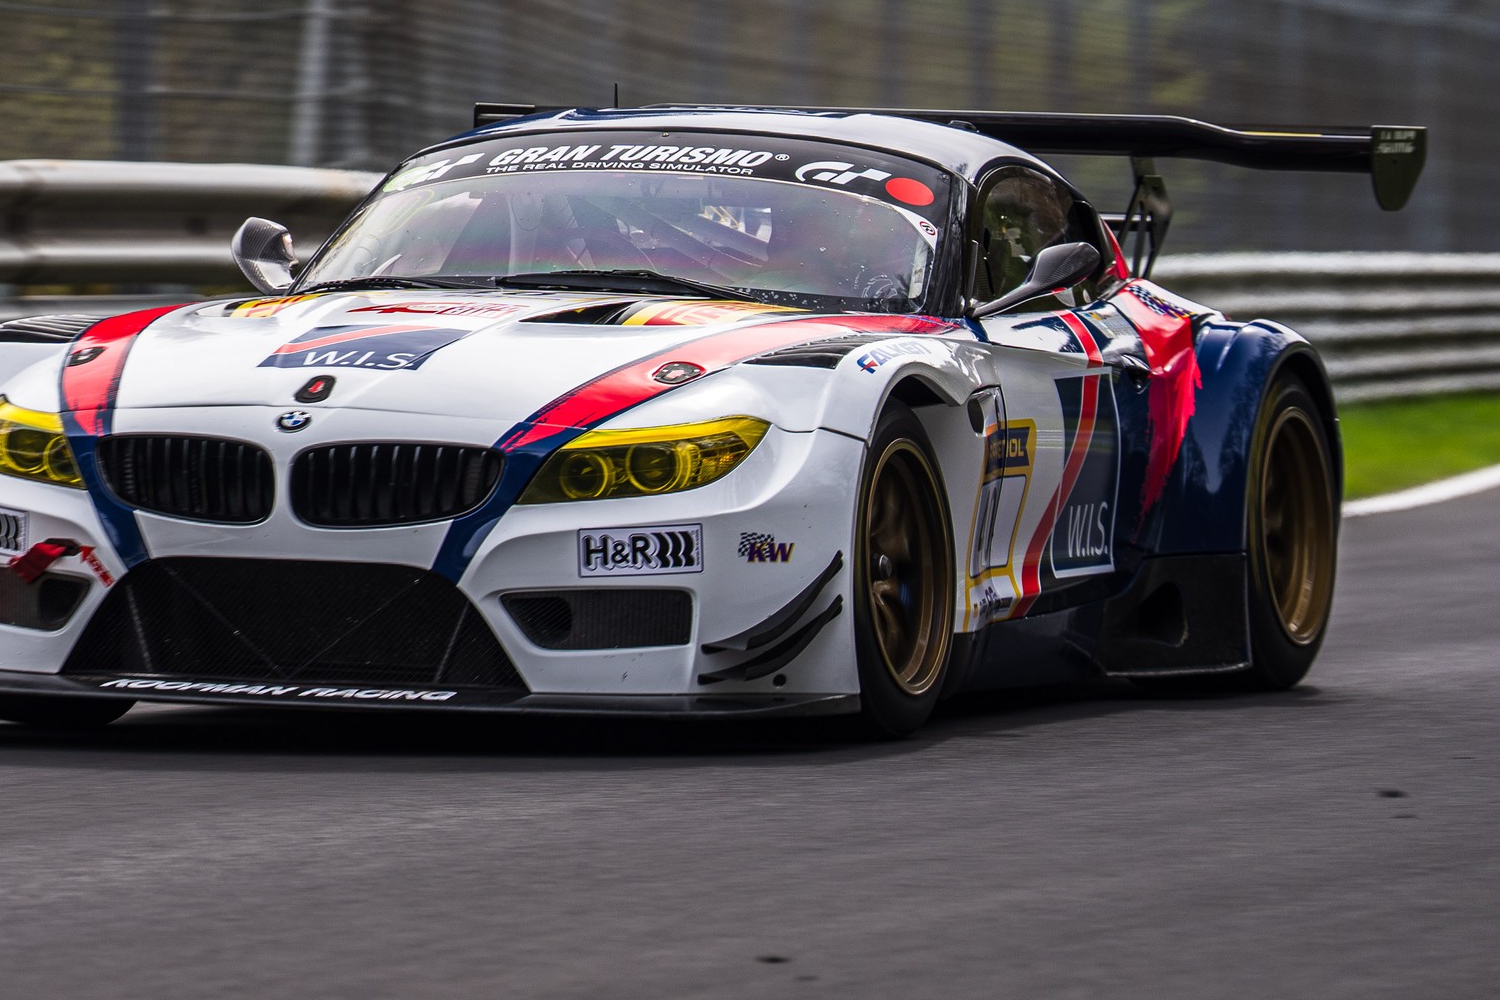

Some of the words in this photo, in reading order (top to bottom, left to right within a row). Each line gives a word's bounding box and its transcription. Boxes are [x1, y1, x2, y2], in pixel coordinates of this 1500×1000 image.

[488, 145, 602, 167] GRAN
[485, 164, 519, 174] THE
[522, 162, 568, 172] REAL
[575, 161, 645, 170] DRIVING
[648, 163, 754, 175] SIMULATOR
[303, 350, 414, 369] W.I.S.
[1068, 501, 1108, 558] W.I.S.
[584, 534, 653, 568] H&R
[747, 543, 795, 563] KW
[100, 678, 299, 696] KOOPMAN
[298, 687, 457, 701] RACING
